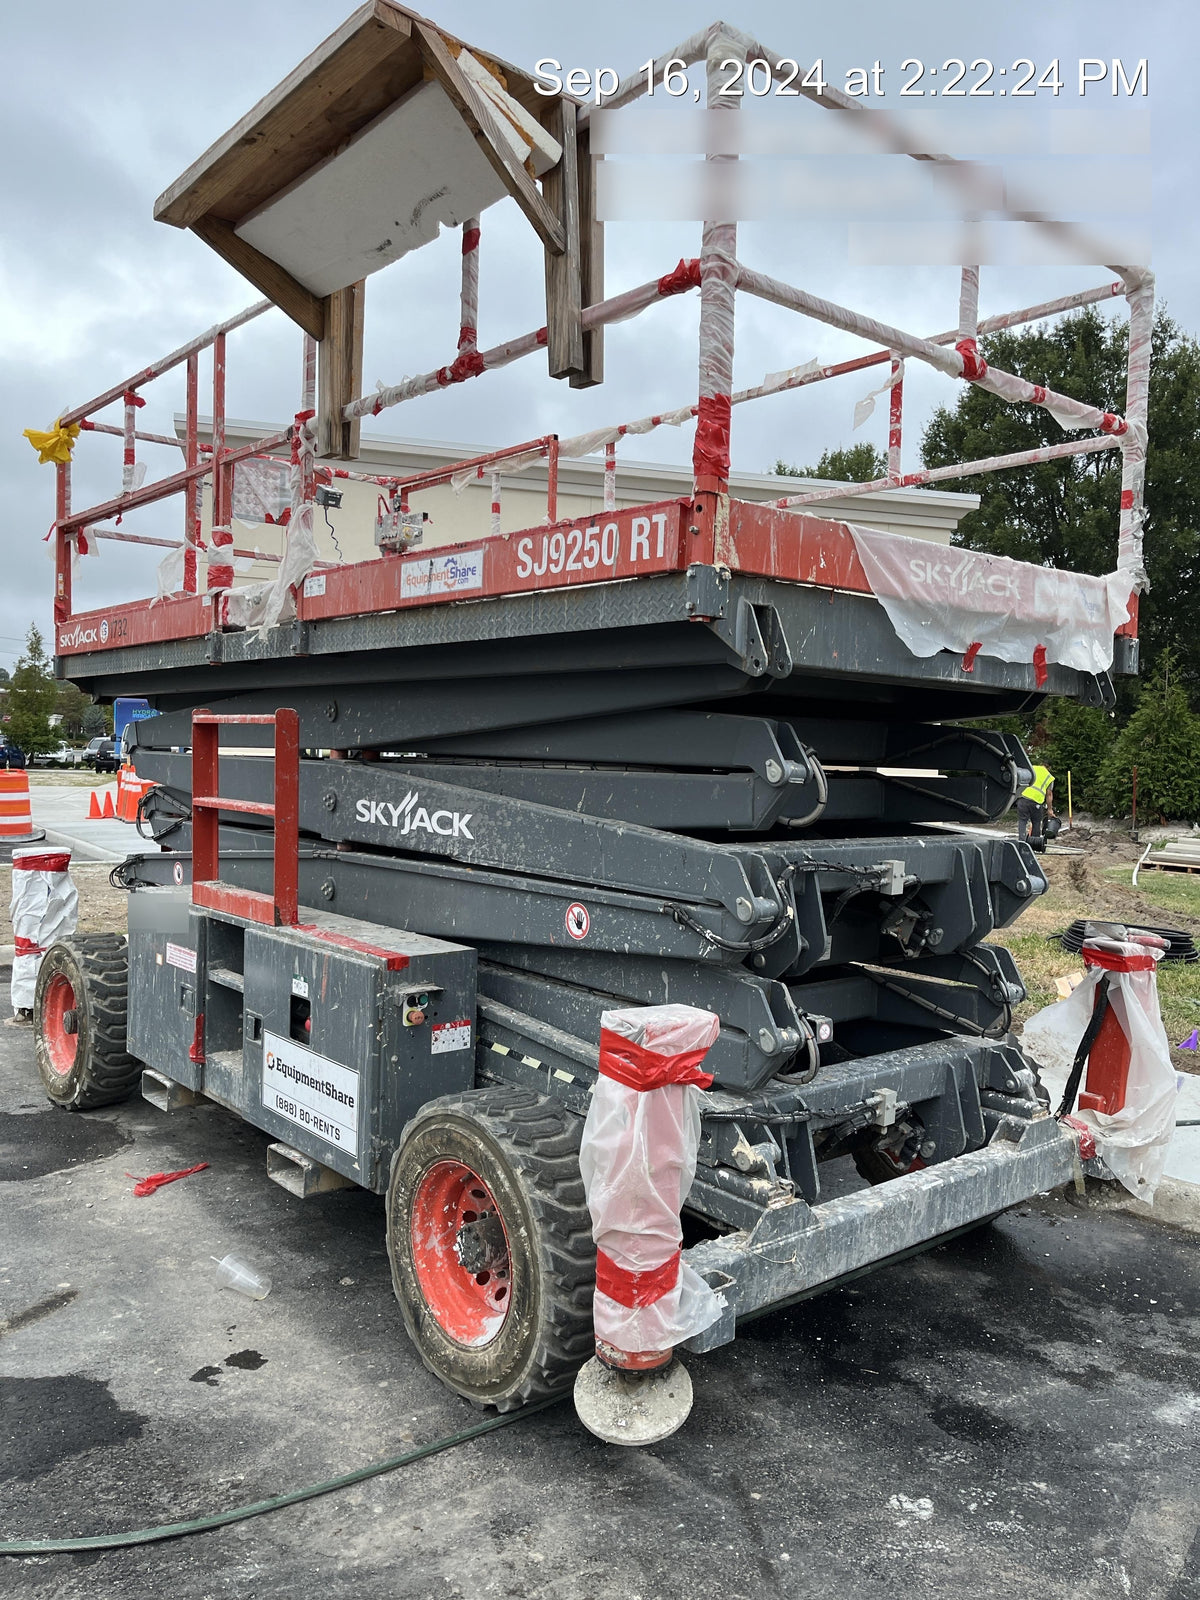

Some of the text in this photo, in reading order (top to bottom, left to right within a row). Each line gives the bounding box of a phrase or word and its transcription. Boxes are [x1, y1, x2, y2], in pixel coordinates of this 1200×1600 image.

[516, 513, 668, 578] SJ9250 RT
[406, 566, 477, 587] EquipmentShare
[909, 553, 1021, 600] SKYJACK
[60, 623, 98, 649] SKYJACK
[356, 790, 475, 840] SKYJACK
[276, 1057, 355, 1108] EquipmentShare
[275, 1094, 341, 1141] (888) 80-RENTS
